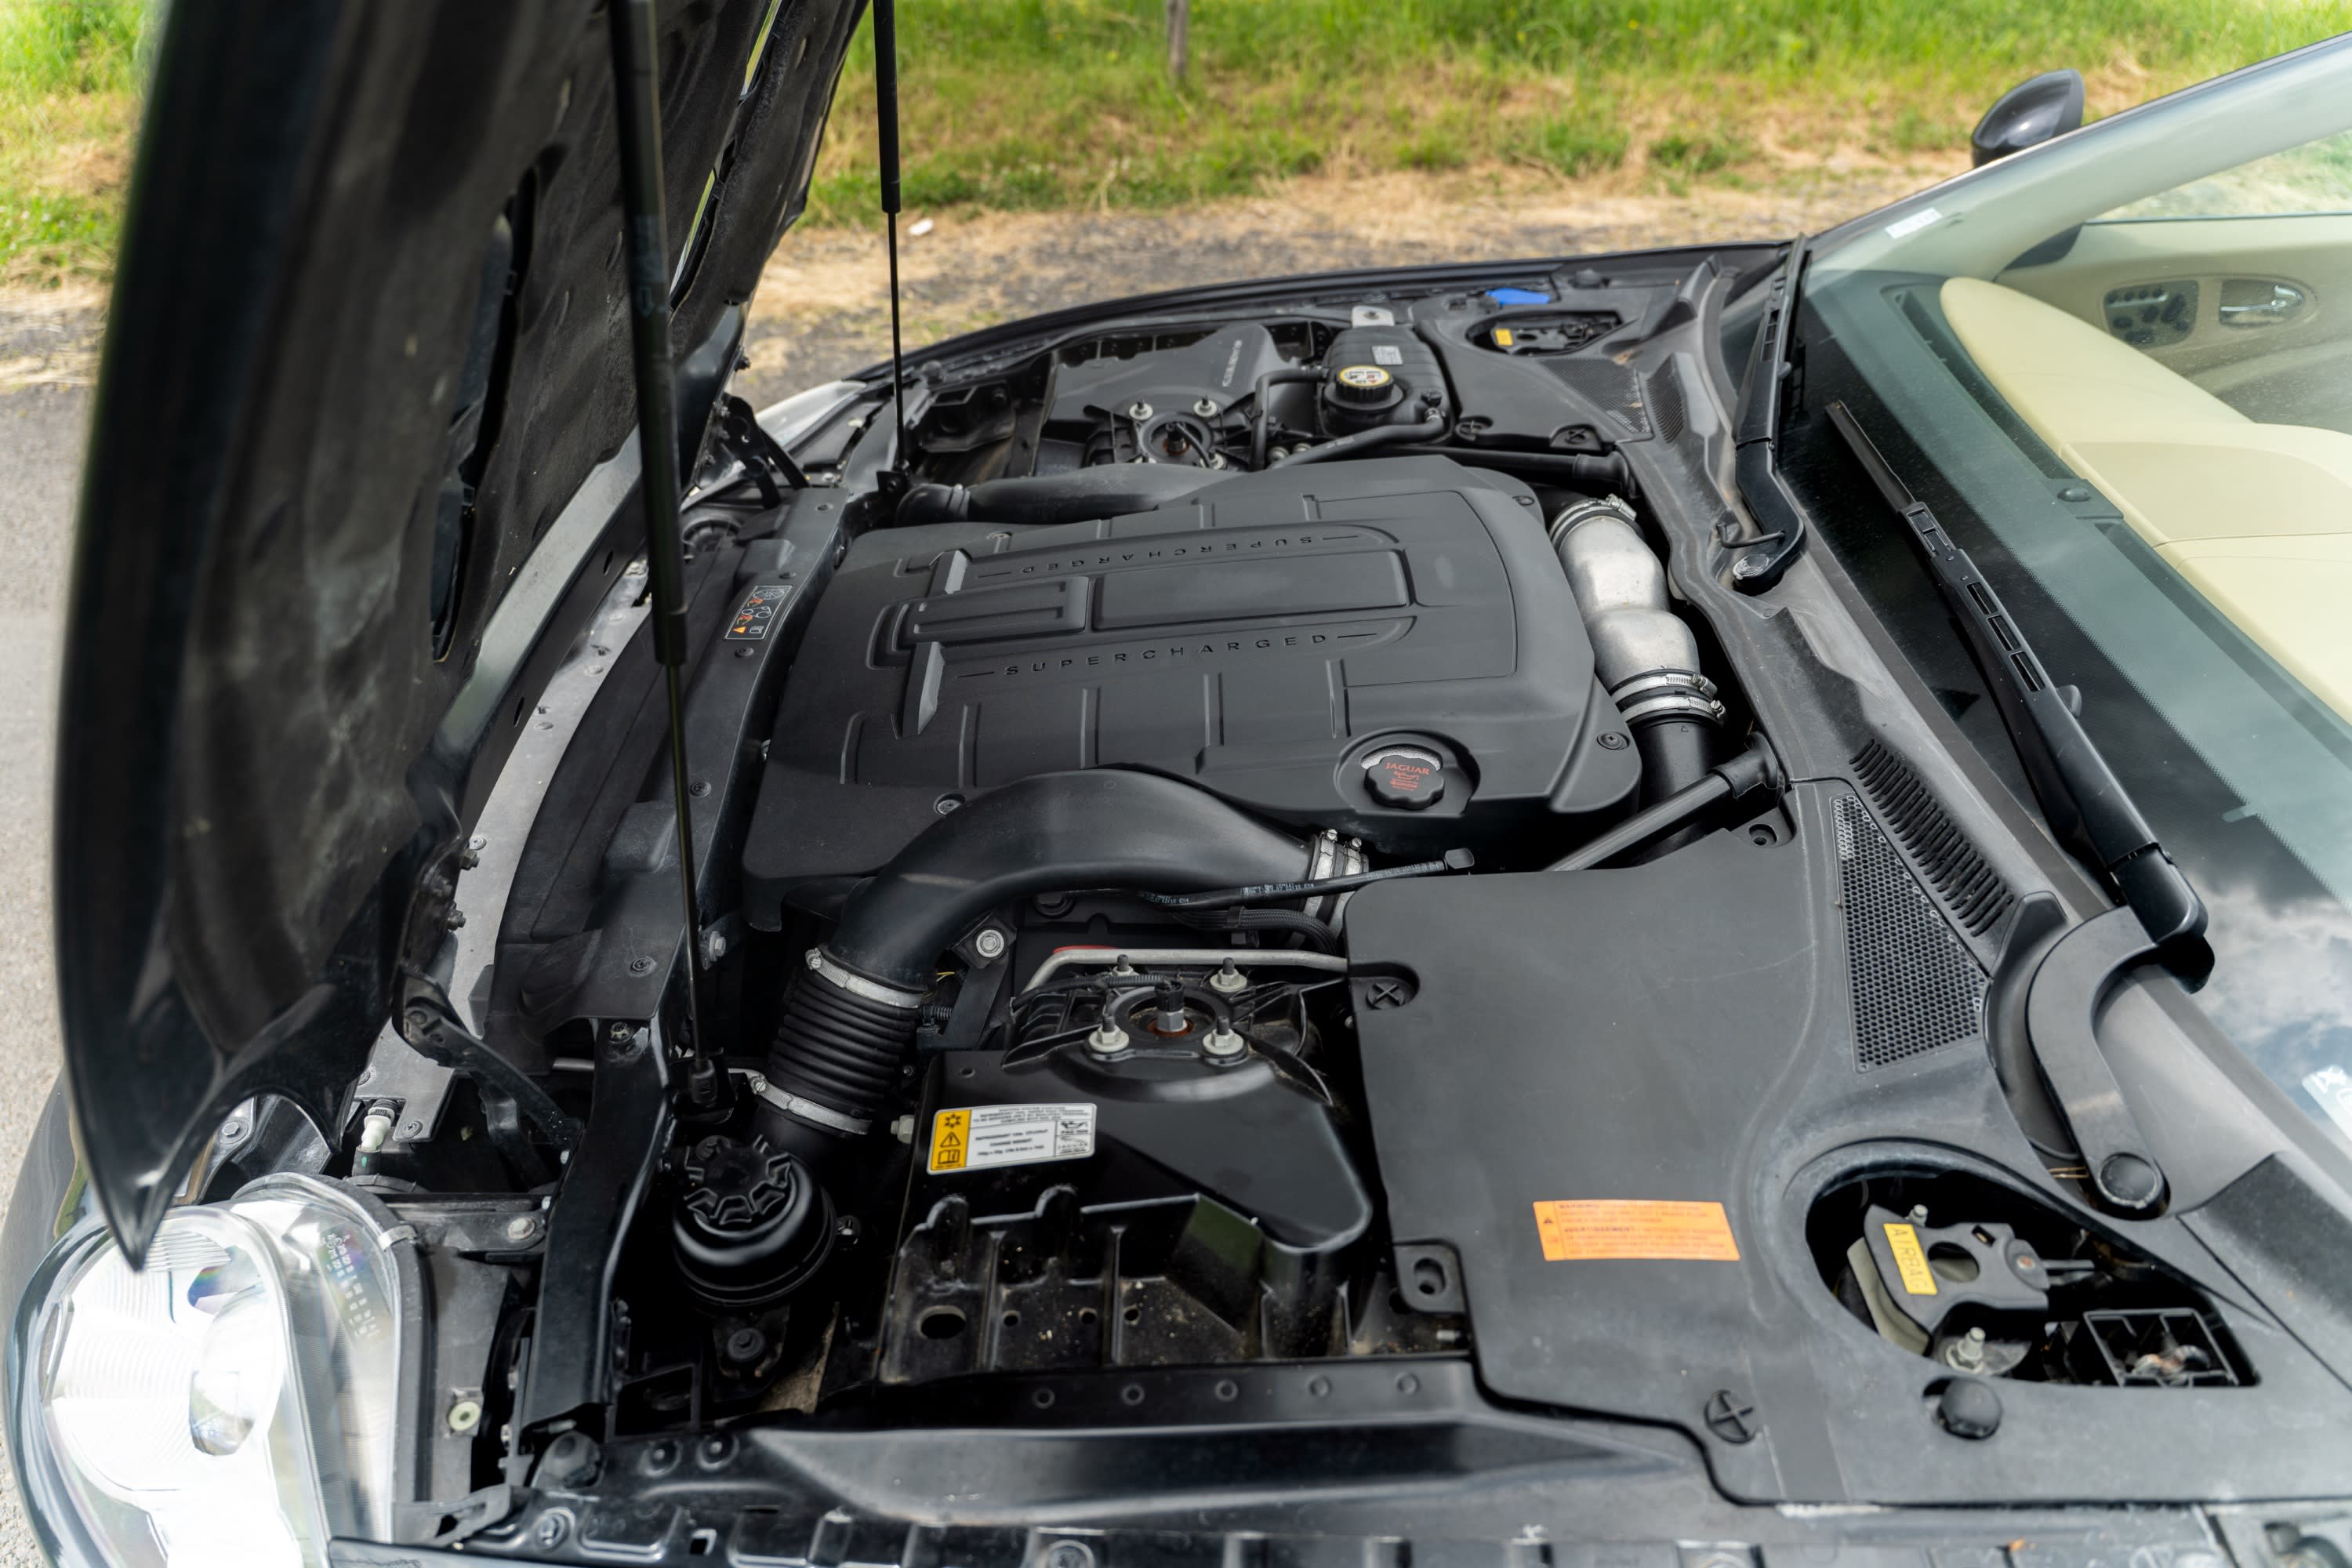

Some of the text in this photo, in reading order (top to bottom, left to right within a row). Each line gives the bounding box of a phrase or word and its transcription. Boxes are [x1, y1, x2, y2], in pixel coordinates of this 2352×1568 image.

[1022, 536, 1312, 573] SUPERCHARGED
[1004, 633, 1327, 675] SUPERCHARGED
[1385, 762, 1430, 775] JAGUAR
[1891, 1229, 1926, 1289] AIRBAG
